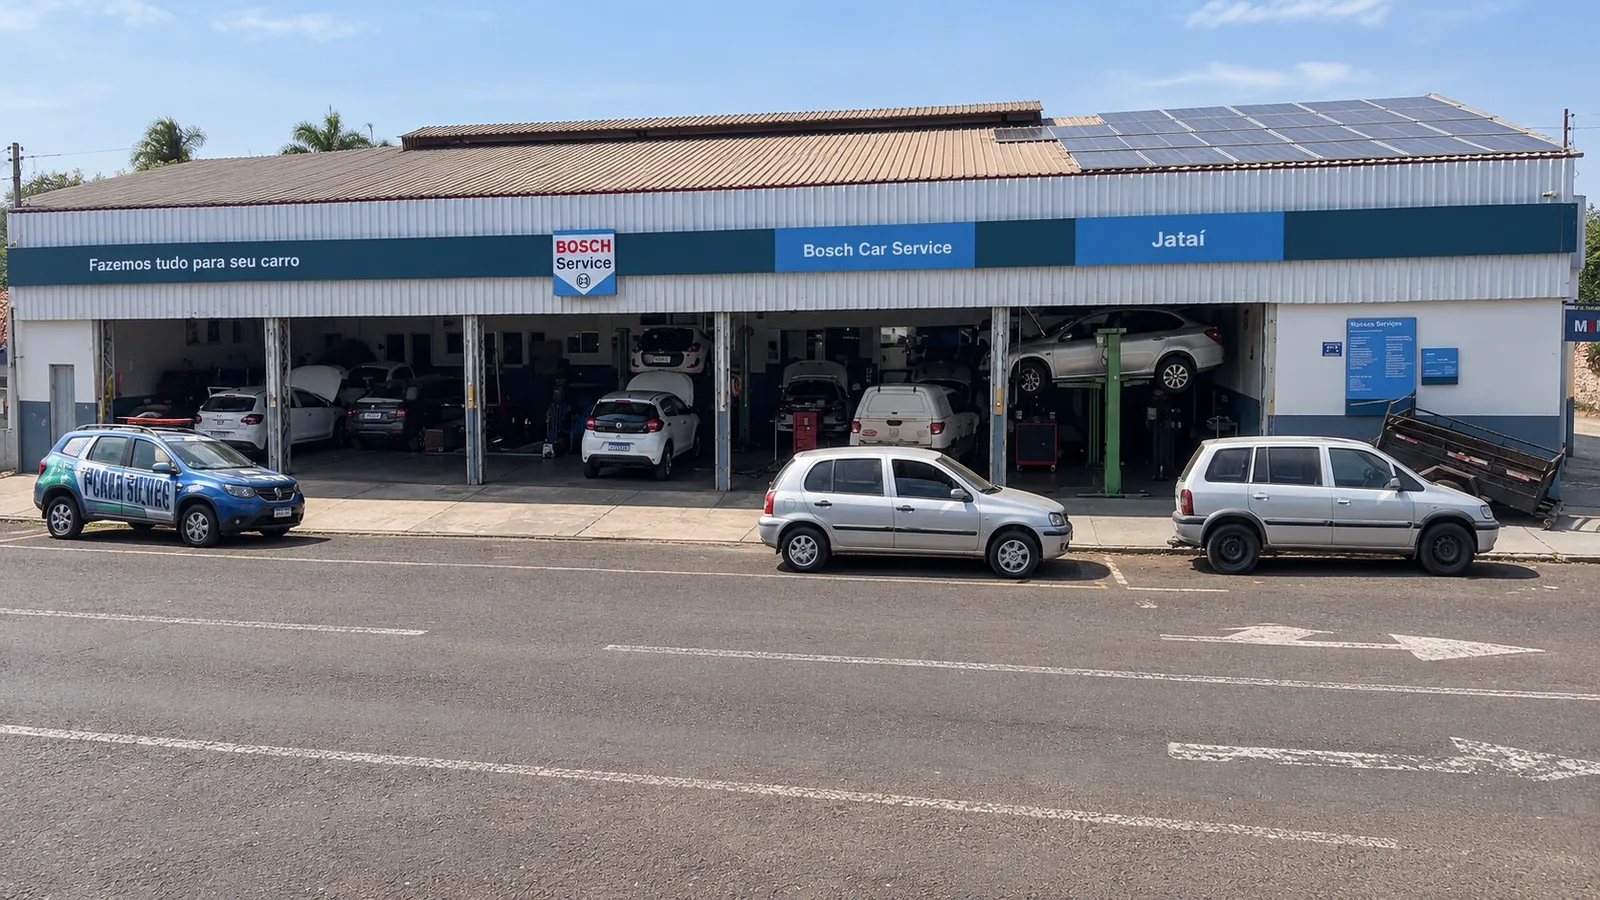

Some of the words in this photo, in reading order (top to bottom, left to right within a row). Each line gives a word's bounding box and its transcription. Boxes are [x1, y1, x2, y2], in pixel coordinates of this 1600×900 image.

[556, 239, 611, 254] BOSCH
[1151, 229, 1206, 248] Jataí
[803, 243, 853, 257] Bosch
[858, 242, 888, 256] Car
[892, 240, 952, 255] Service
[89, 258, 151, 271] Fazemos
[155, 256, 188, 270] tudo
[193, 257, 225, 272] para
[229, 257, 256, 268] seu
[260, 256, 300, 267] carro
[556, 256, 612, 270] Service
